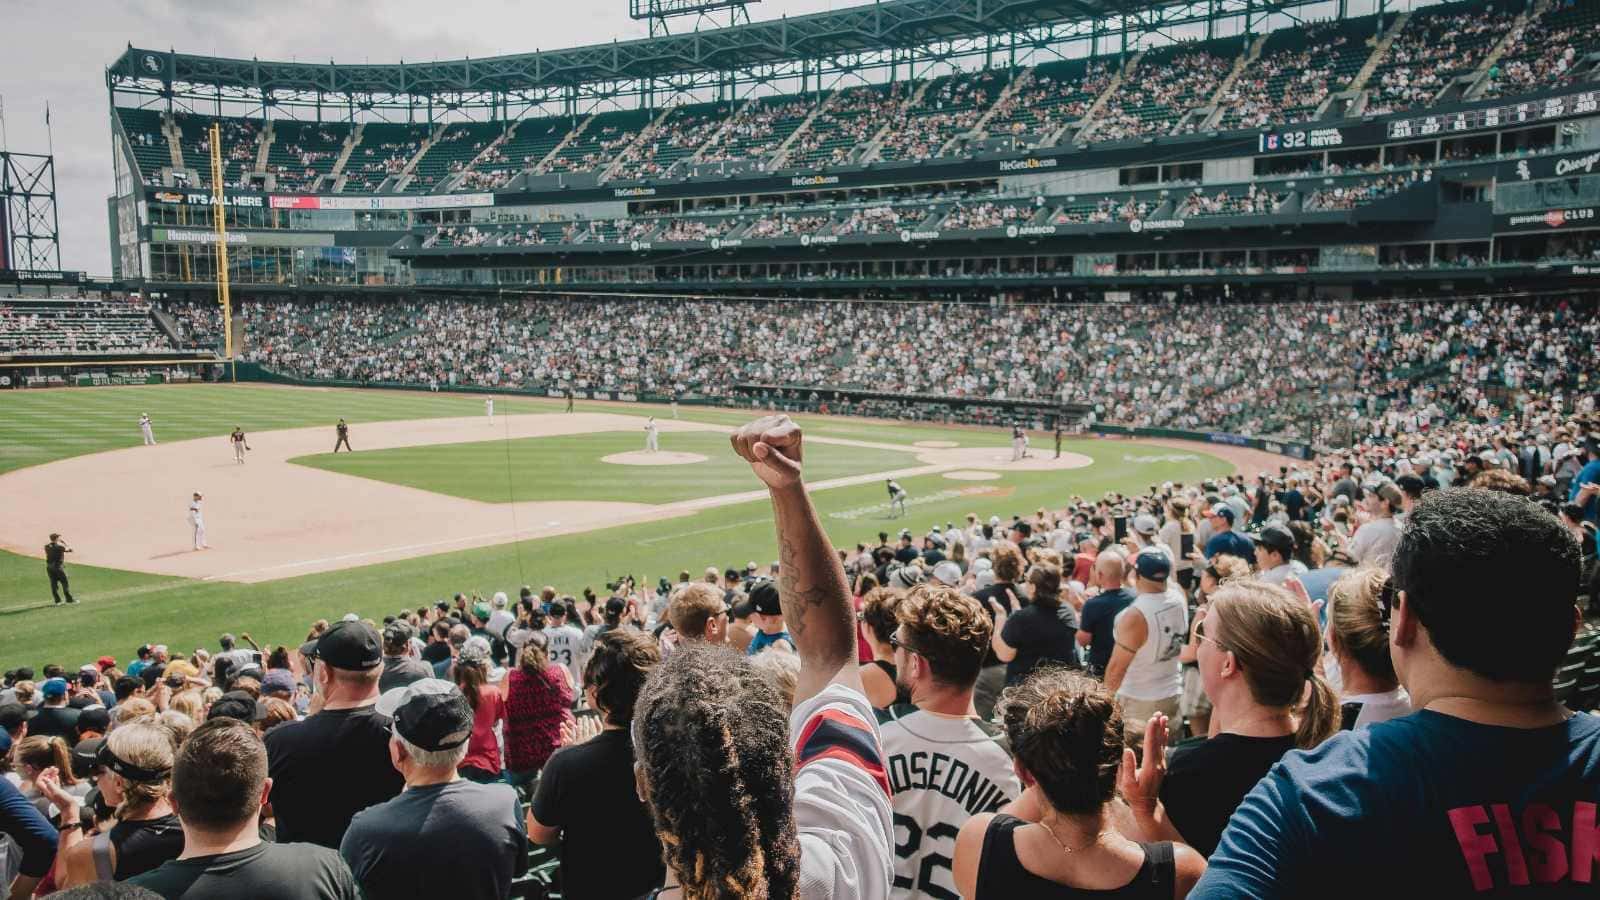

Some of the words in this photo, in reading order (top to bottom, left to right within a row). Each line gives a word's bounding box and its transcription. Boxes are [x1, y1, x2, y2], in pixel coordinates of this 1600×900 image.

[1283, 131, 1306, 148] 32
[1310, 134, 1343, 147] REYES
[187, 193, 208, 204] IT'S
[232, 196, 262, 206] HERE
[1564, 208, 1595, 220] CLUB
